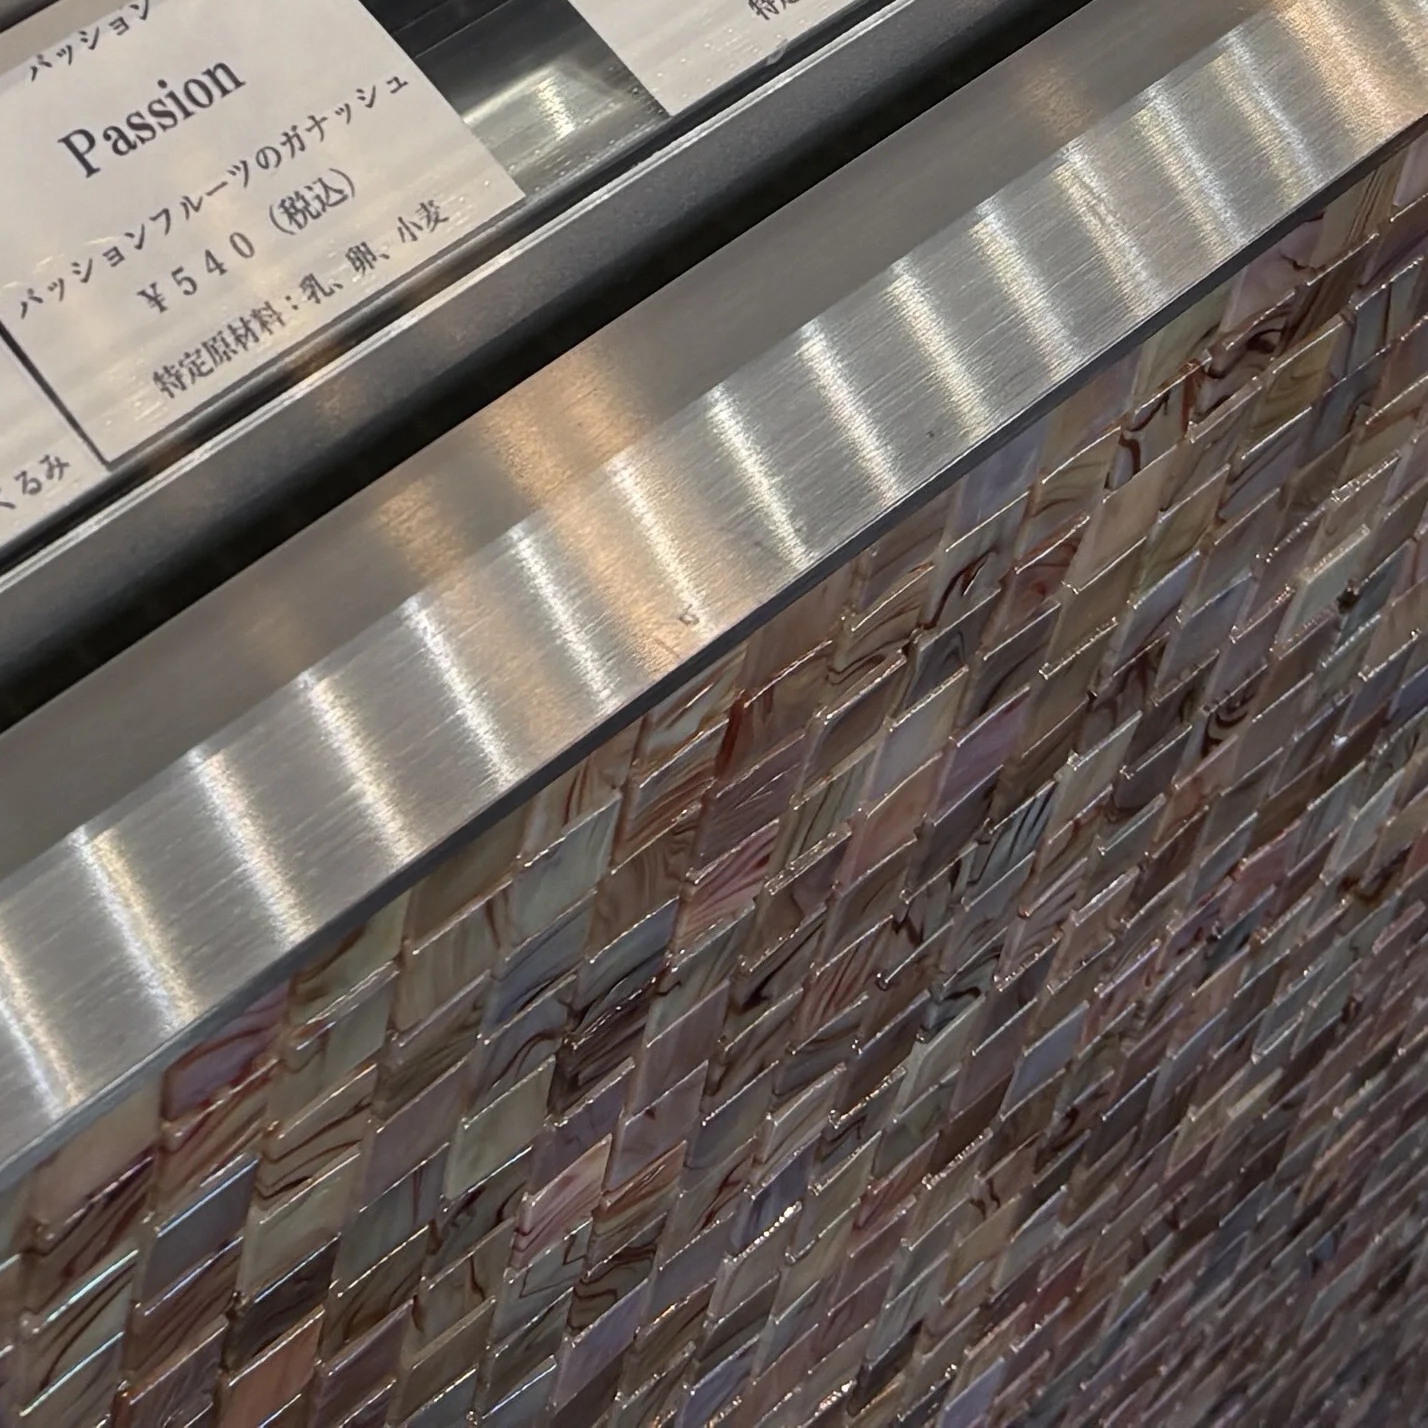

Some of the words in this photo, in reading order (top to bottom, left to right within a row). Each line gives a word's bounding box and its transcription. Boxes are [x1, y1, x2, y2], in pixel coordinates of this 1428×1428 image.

[18, 76, 409, 319] パッションフルーツのガナッシュ
[56, 60, 246, 178] Passion
